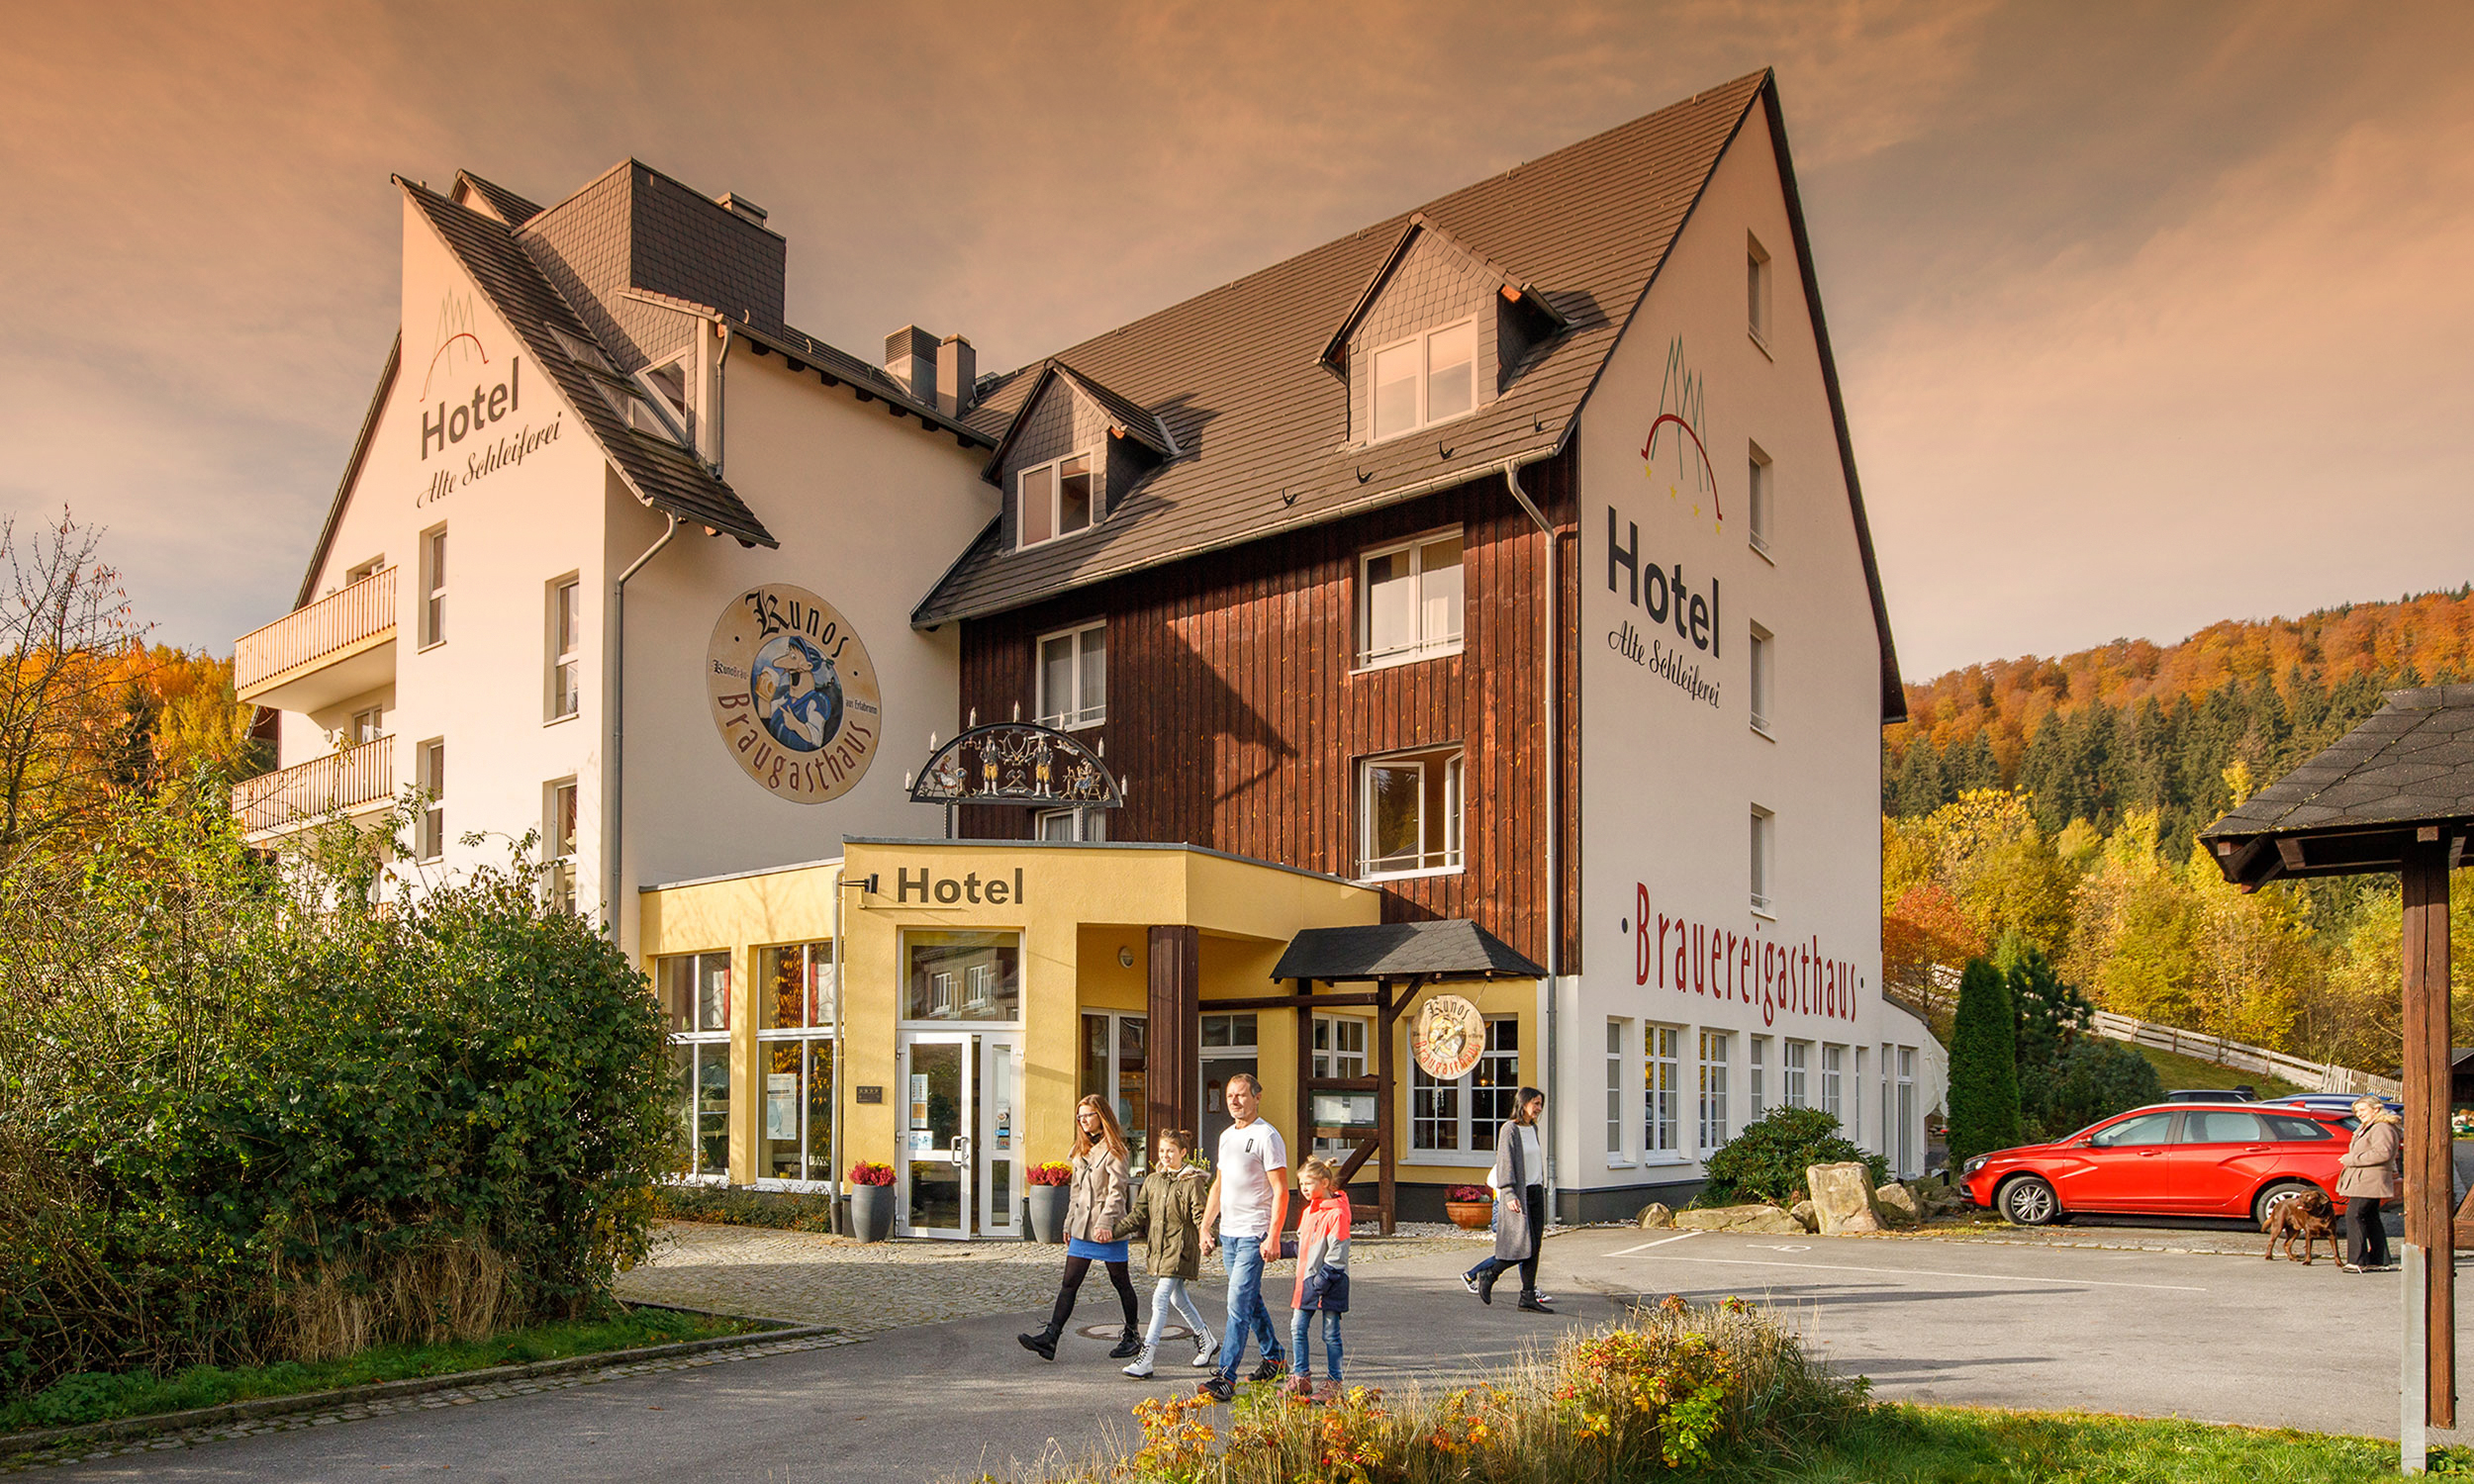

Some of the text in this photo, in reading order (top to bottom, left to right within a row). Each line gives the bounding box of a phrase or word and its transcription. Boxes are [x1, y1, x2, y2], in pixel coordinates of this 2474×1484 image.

[421, 355, 520, 461] Hotel
[416, 411, 562, 509] Alte Schleiferei
[744, 589, 849, 659] Kunos
[1608, 505, 1720, 660] Hotel
[1607, 619, 1720, 709] Alte Schleiferei
[717, 693, 872, 793] Braugasthaus
[898, 867, 1023, 905] Hotel
[1636, 881, 1856, 1028] Brauereigasthaus
[1425, 999, 1471, 1021] Kunos
[1414, 1040, 1481, 1075] Braugasthaus
